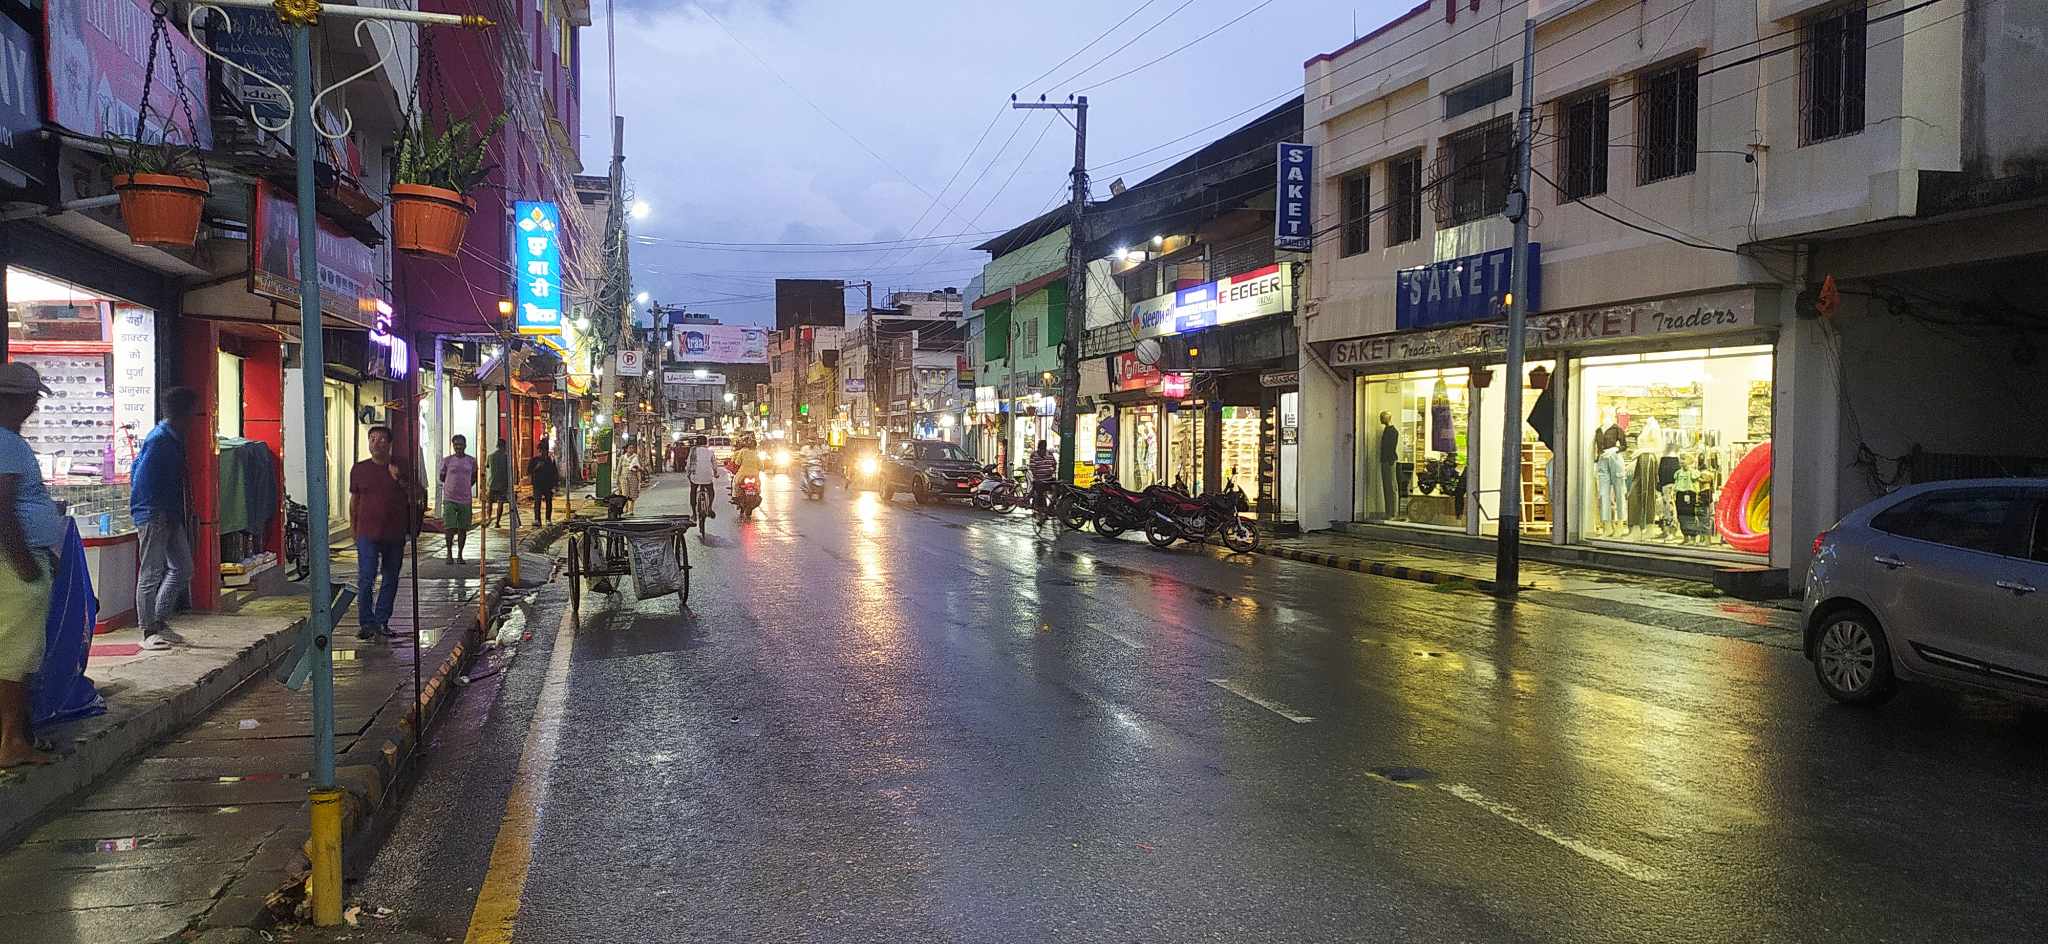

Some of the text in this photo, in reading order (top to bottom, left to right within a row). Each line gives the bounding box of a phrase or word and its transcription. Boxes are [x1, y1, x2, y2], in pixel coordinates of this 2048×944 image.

[1288, 148, 1304, 234] SAKET
[1230, 276, 1281, 302] EGGER
[1409, 253, 1505, 306] SAKET
[1545, 305, 1646, 341] SAKET
[1652, 307, 1738, 332] Traders
[1336, 338, 1441, 363] SAKET Traders
